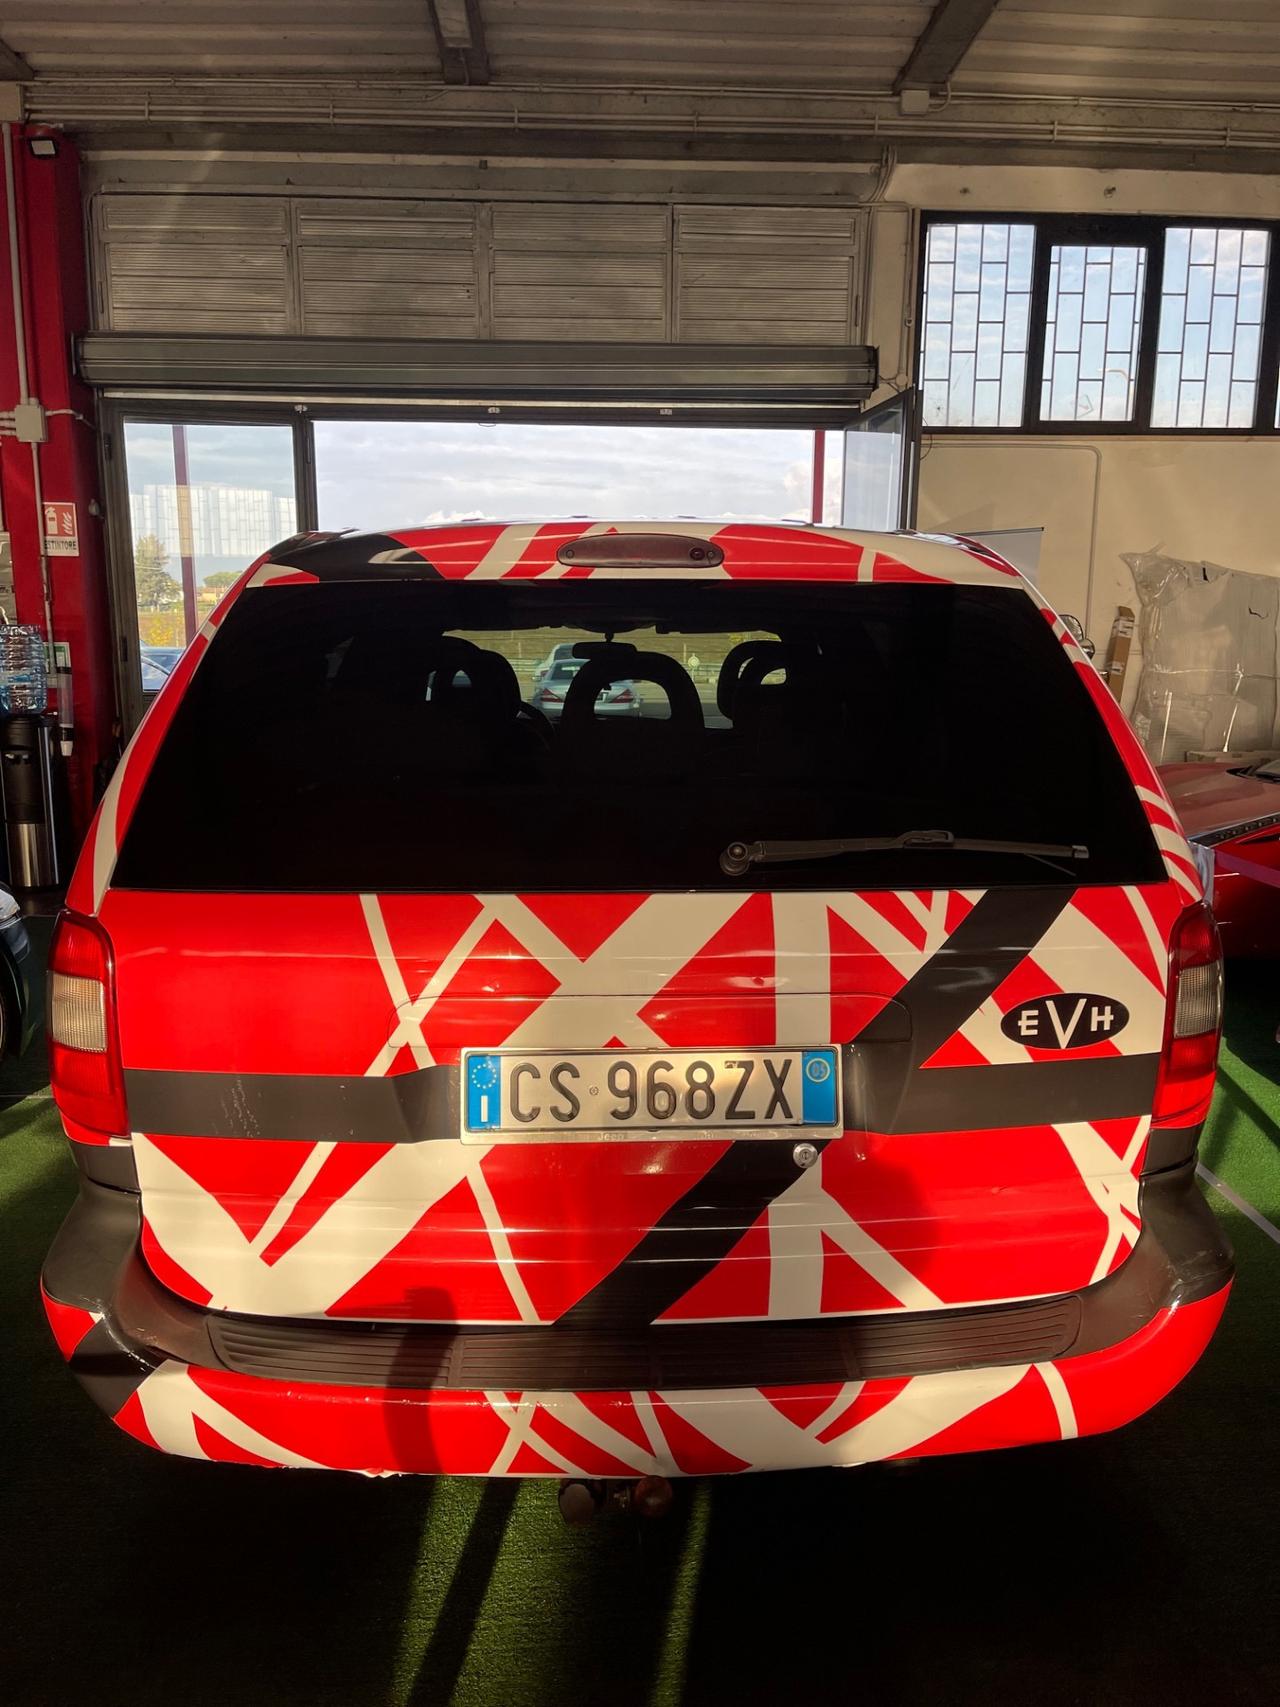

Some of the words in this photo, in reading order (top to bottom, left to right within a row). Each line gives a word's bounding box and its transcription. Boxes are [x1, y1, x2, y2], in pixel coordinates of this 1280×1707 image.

[1018, 998, 1114, 1050] EVH
[510, 1061, 581, 1123] CS
[607, 1059, 794, 1121] 968ZX
